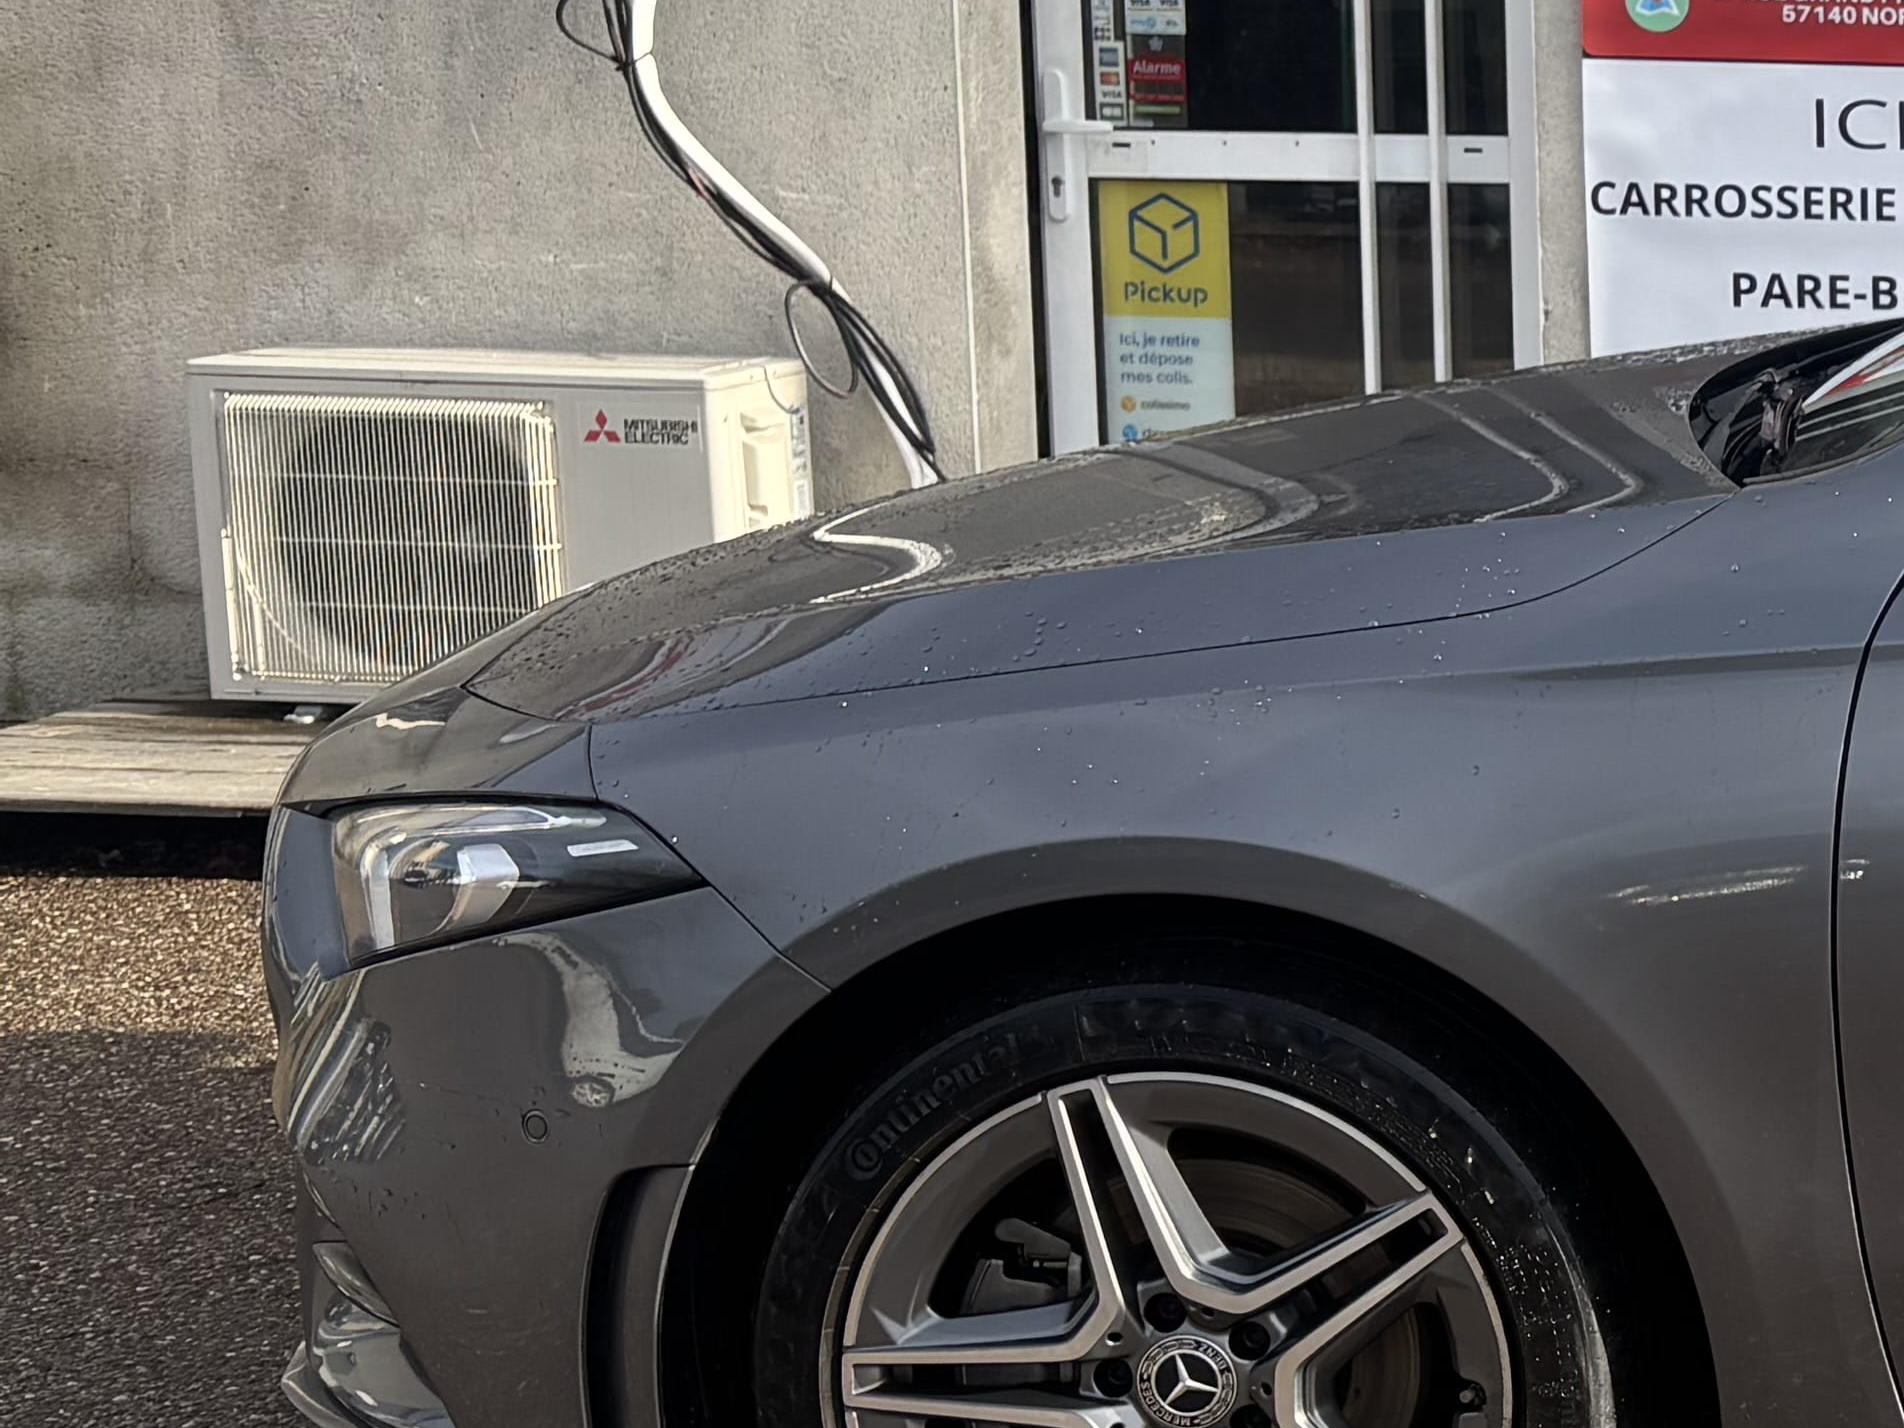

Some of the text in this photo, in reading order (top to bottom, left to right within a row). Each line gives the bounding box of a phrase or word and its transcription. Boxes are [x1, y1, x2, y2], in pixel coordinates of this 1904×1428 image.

[1782, 6, 1856, 25] 57140
[1133, 59, 1182, 75] Alarme
[1591, 180, 1897, 223] CARROSSERIE
[1124, 281, 1208, 308] Pickup
[1120, 332, 1200, 349] Ici, je retire
[1120, 352, 1193, 368] et dépose
[1120, 372, 1193, 384] mes colis.
[624, 418, 698, 433] MITSUBISHI
[624, 431, 689, 445] ELECTRIC
[1198, 1342, 1228, 1371] BENZ
[1140, 1380, 1192, 1427] MERCEDES
